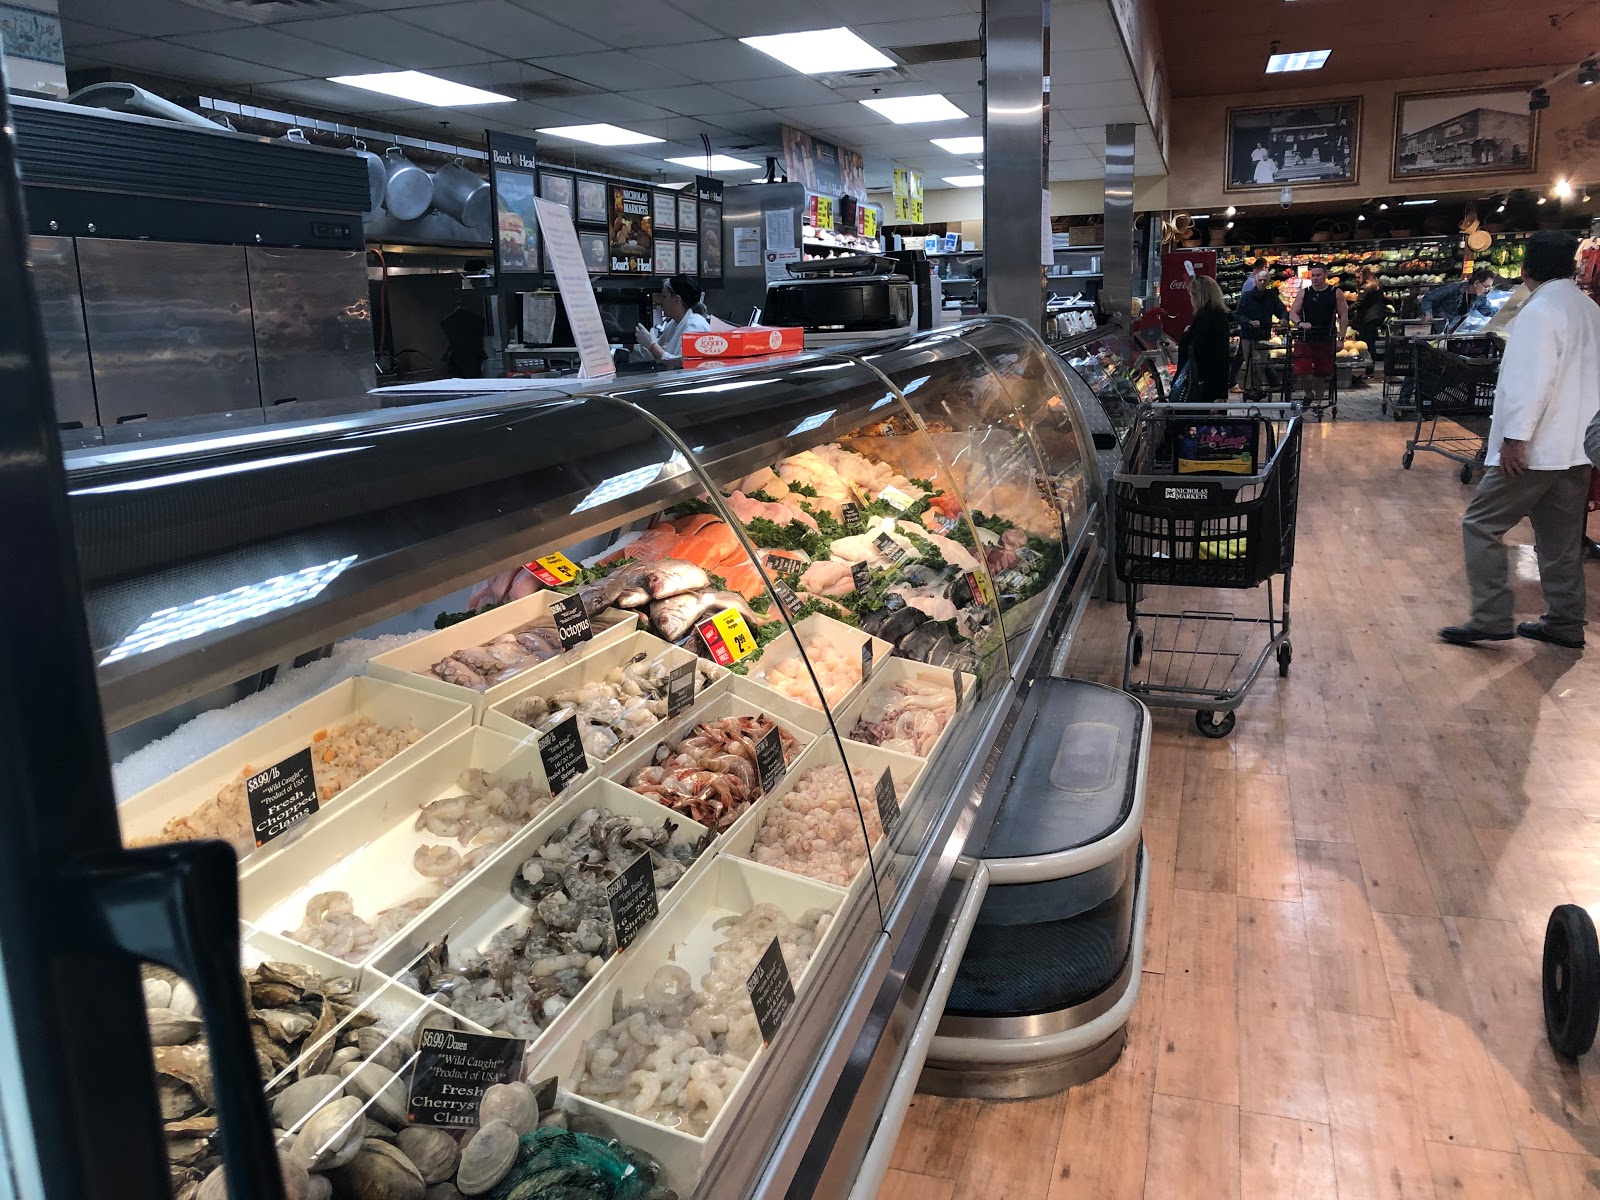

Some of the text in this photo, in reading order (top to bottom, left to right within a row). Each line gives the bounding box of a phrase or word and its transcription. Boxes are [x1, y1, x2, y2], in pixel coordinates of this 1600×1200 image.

[493, 150, 535, 168] Boar's Head
[623, 190, 648, 202] NICHOLAS
[623, 203, 648, 215] MARKETS
[612, 256, 652, 272] Boar's Head
[560, 619, 589, 640] Octopus
[248, 767, 280, 793] $8.99/lb
[287, 784, 292, 793] of
[256, 791, 316, 832] Chopped
[268, 791, 304, 816] Fresh
[268, 807, 309, 836] Clams
[616, 918, 627, 930] 16
[636, 900, 645, 913] 20
[625, 904, 652, 934] Shrimp
[622, 926, 638, 945] Tail
[645, 909, 656, 922] On
[422, 1031, 467, 1051] $6.99/Dozen
[470, 1071, 479, 1080] of
[441, 1084, 483, 1096] Fresh
